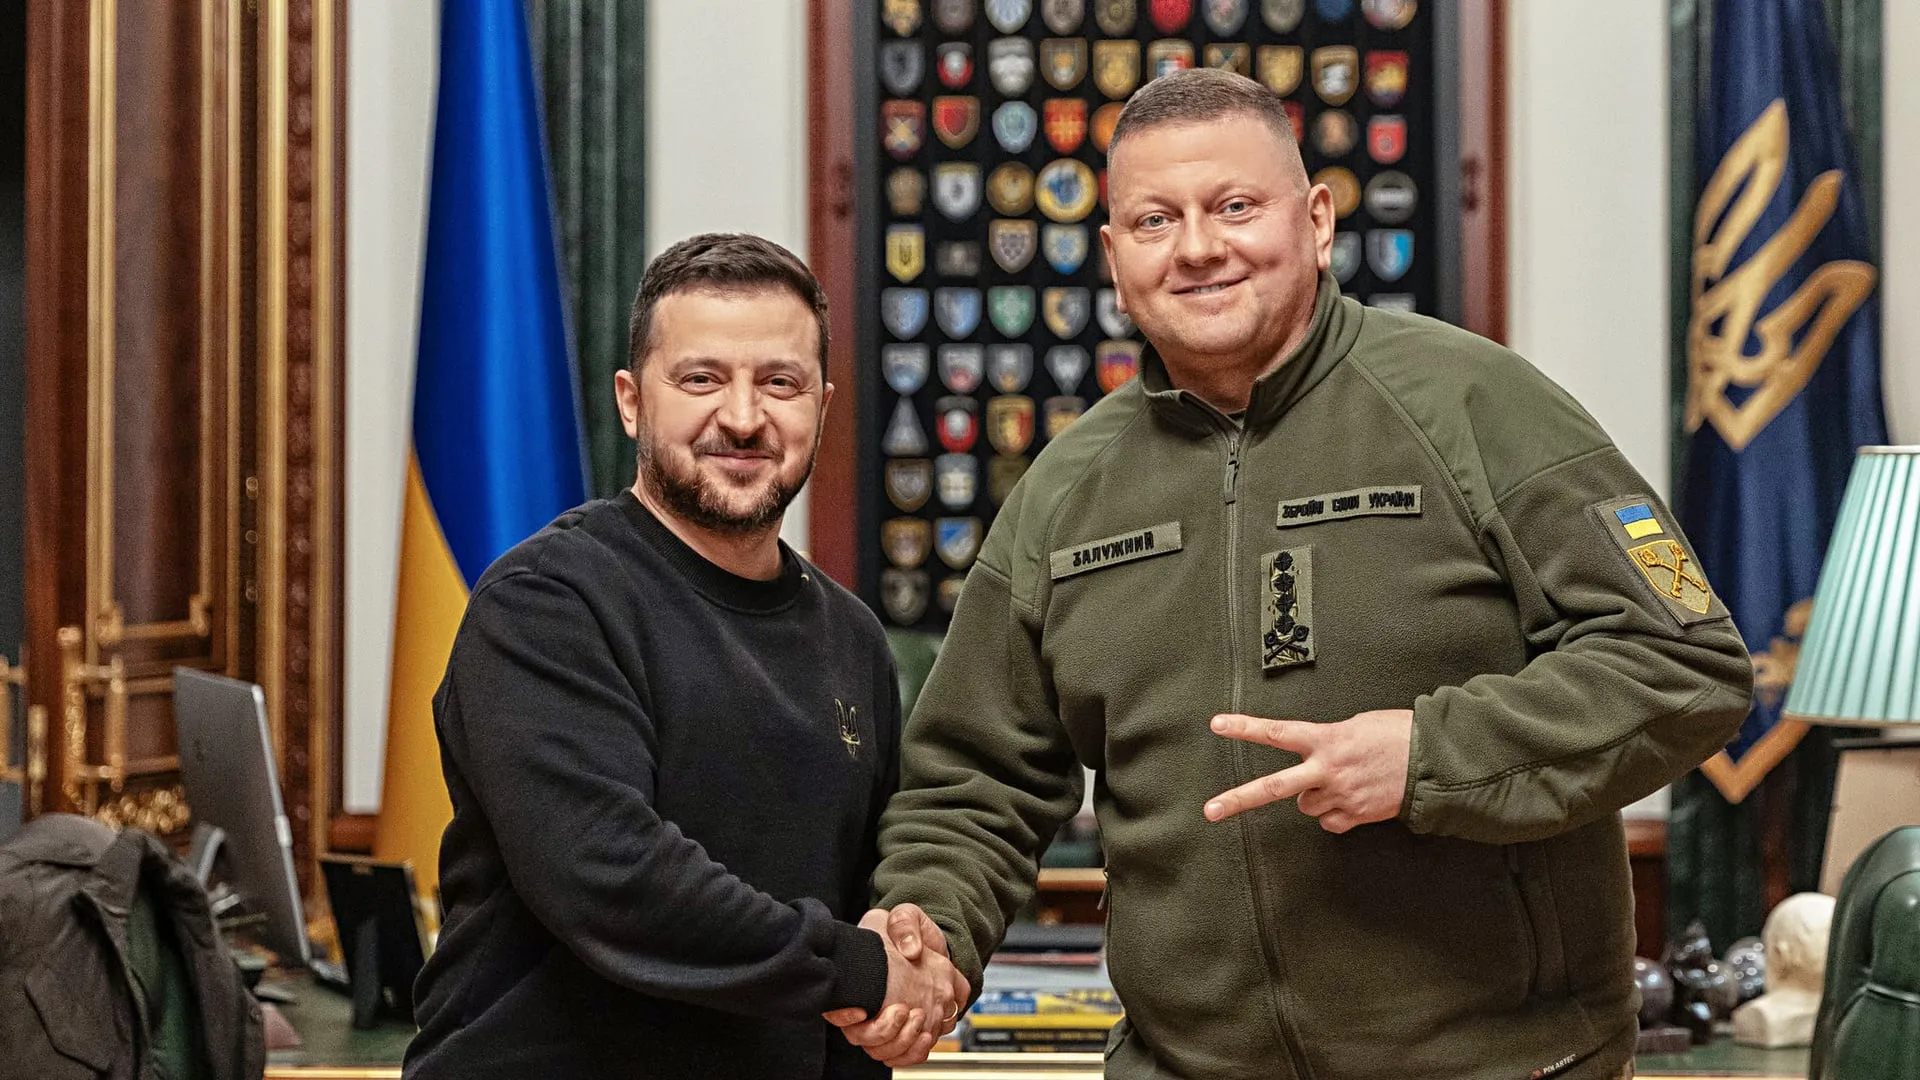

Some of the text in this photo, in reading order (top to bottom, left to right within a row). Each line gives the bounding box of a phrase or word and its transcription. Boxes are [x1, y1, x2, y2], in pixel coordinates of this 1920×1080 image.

[1369, 491, 1415, 509] УКРАЇНИ
[1073, 531, 1154, 567] ЗАЛУЖНИЙ
[1543, 1053, 1576, 1074] POLARTEC
